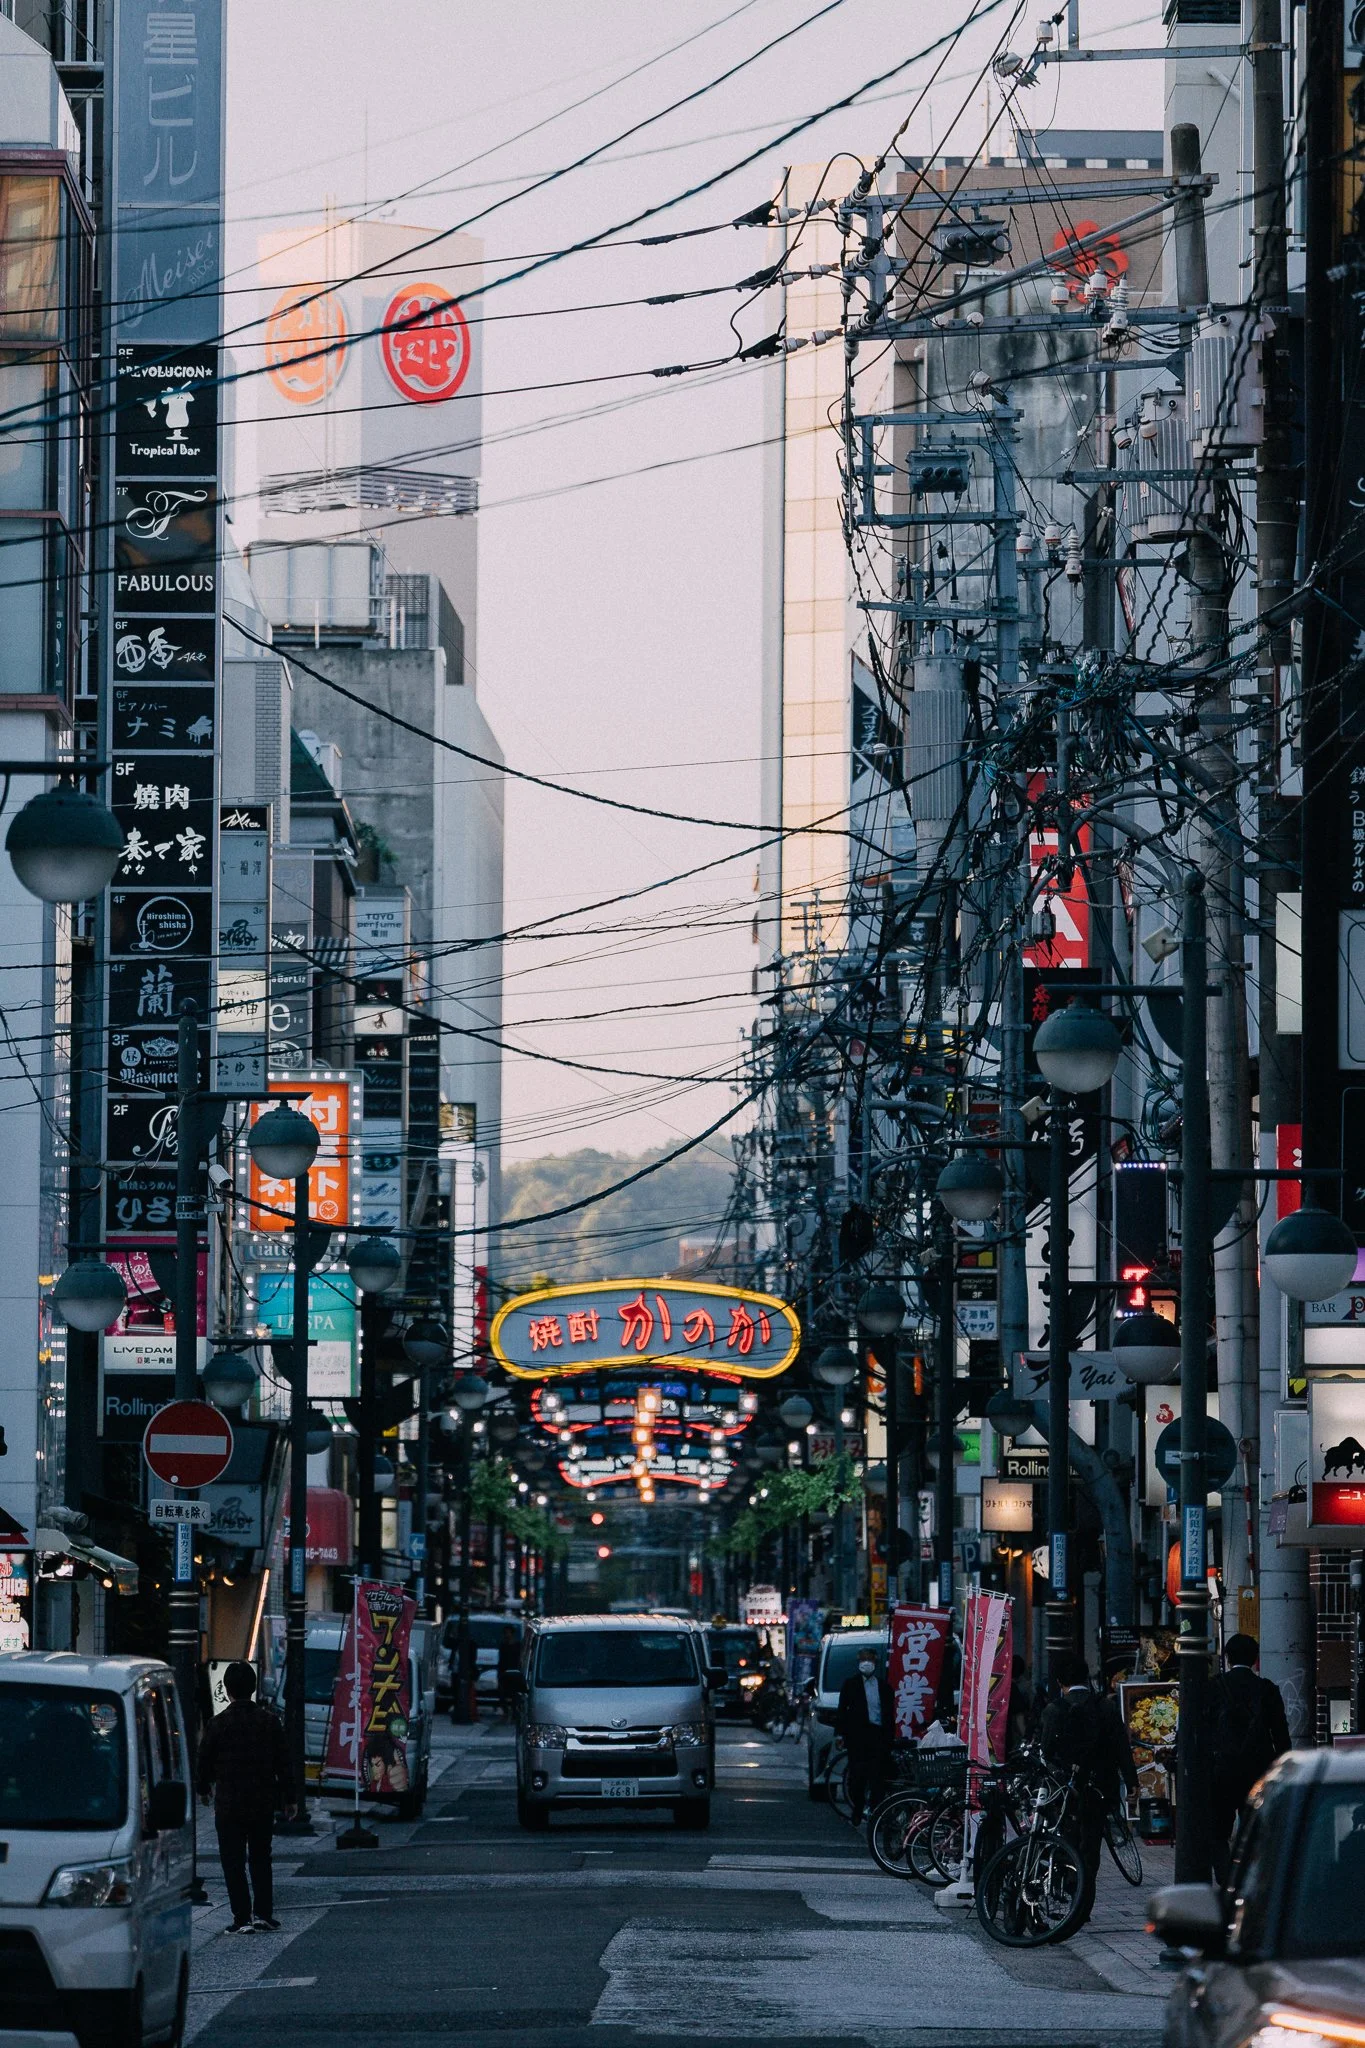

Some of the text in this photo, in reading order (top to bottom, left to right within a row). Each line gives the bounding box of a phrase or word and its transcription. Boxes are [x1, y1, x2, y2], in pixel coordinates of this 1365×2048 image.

[130, 443, 201, 459] Tropical Bar
[116, 487, 129, 497] 7F
[117, 575, 214, 593] FABULOUS
[115, 621, 129, 630] 6F
[116, 691, 129, 699] 6F
[127, 716, 177, 738] ナミ
[115, 762, 136, 777] 5F
[133, 783, 191, 811] 焼肉
[118, 826, 207, 862] 奏で家
[253, 840, 264, 849] 4F
[113, 896, 126, 904] 4F
[253, 907, 264, 915] 3F
[357, 921, 402, 929] perfume
[112, 965, 126, 973] 4F
[112, 1034, 130, 1047] 3F
[119, 1068, 202, 1088] Masquere
[113, 1104, 129, 1116] 2F
[257, 1170, 342, 1201] ネト
[972, 1291, 984, 1299] 3F
[1311, 1302, 1337, 1313] BAR
[617, 1291, 772, 1355] かのか
[529, 1308, 600, 1352] 焼酎
[113, 1346, 173, 1354] LIVEDAM
[1079, 1365, 1117, 1391] Yai
[1338, 1488, 1365, 1500] ニュ
[155, 1506, 206, 1519] 自転車を除く
[1188, 1508, 1200, 1575] 防犯カメラ設置
